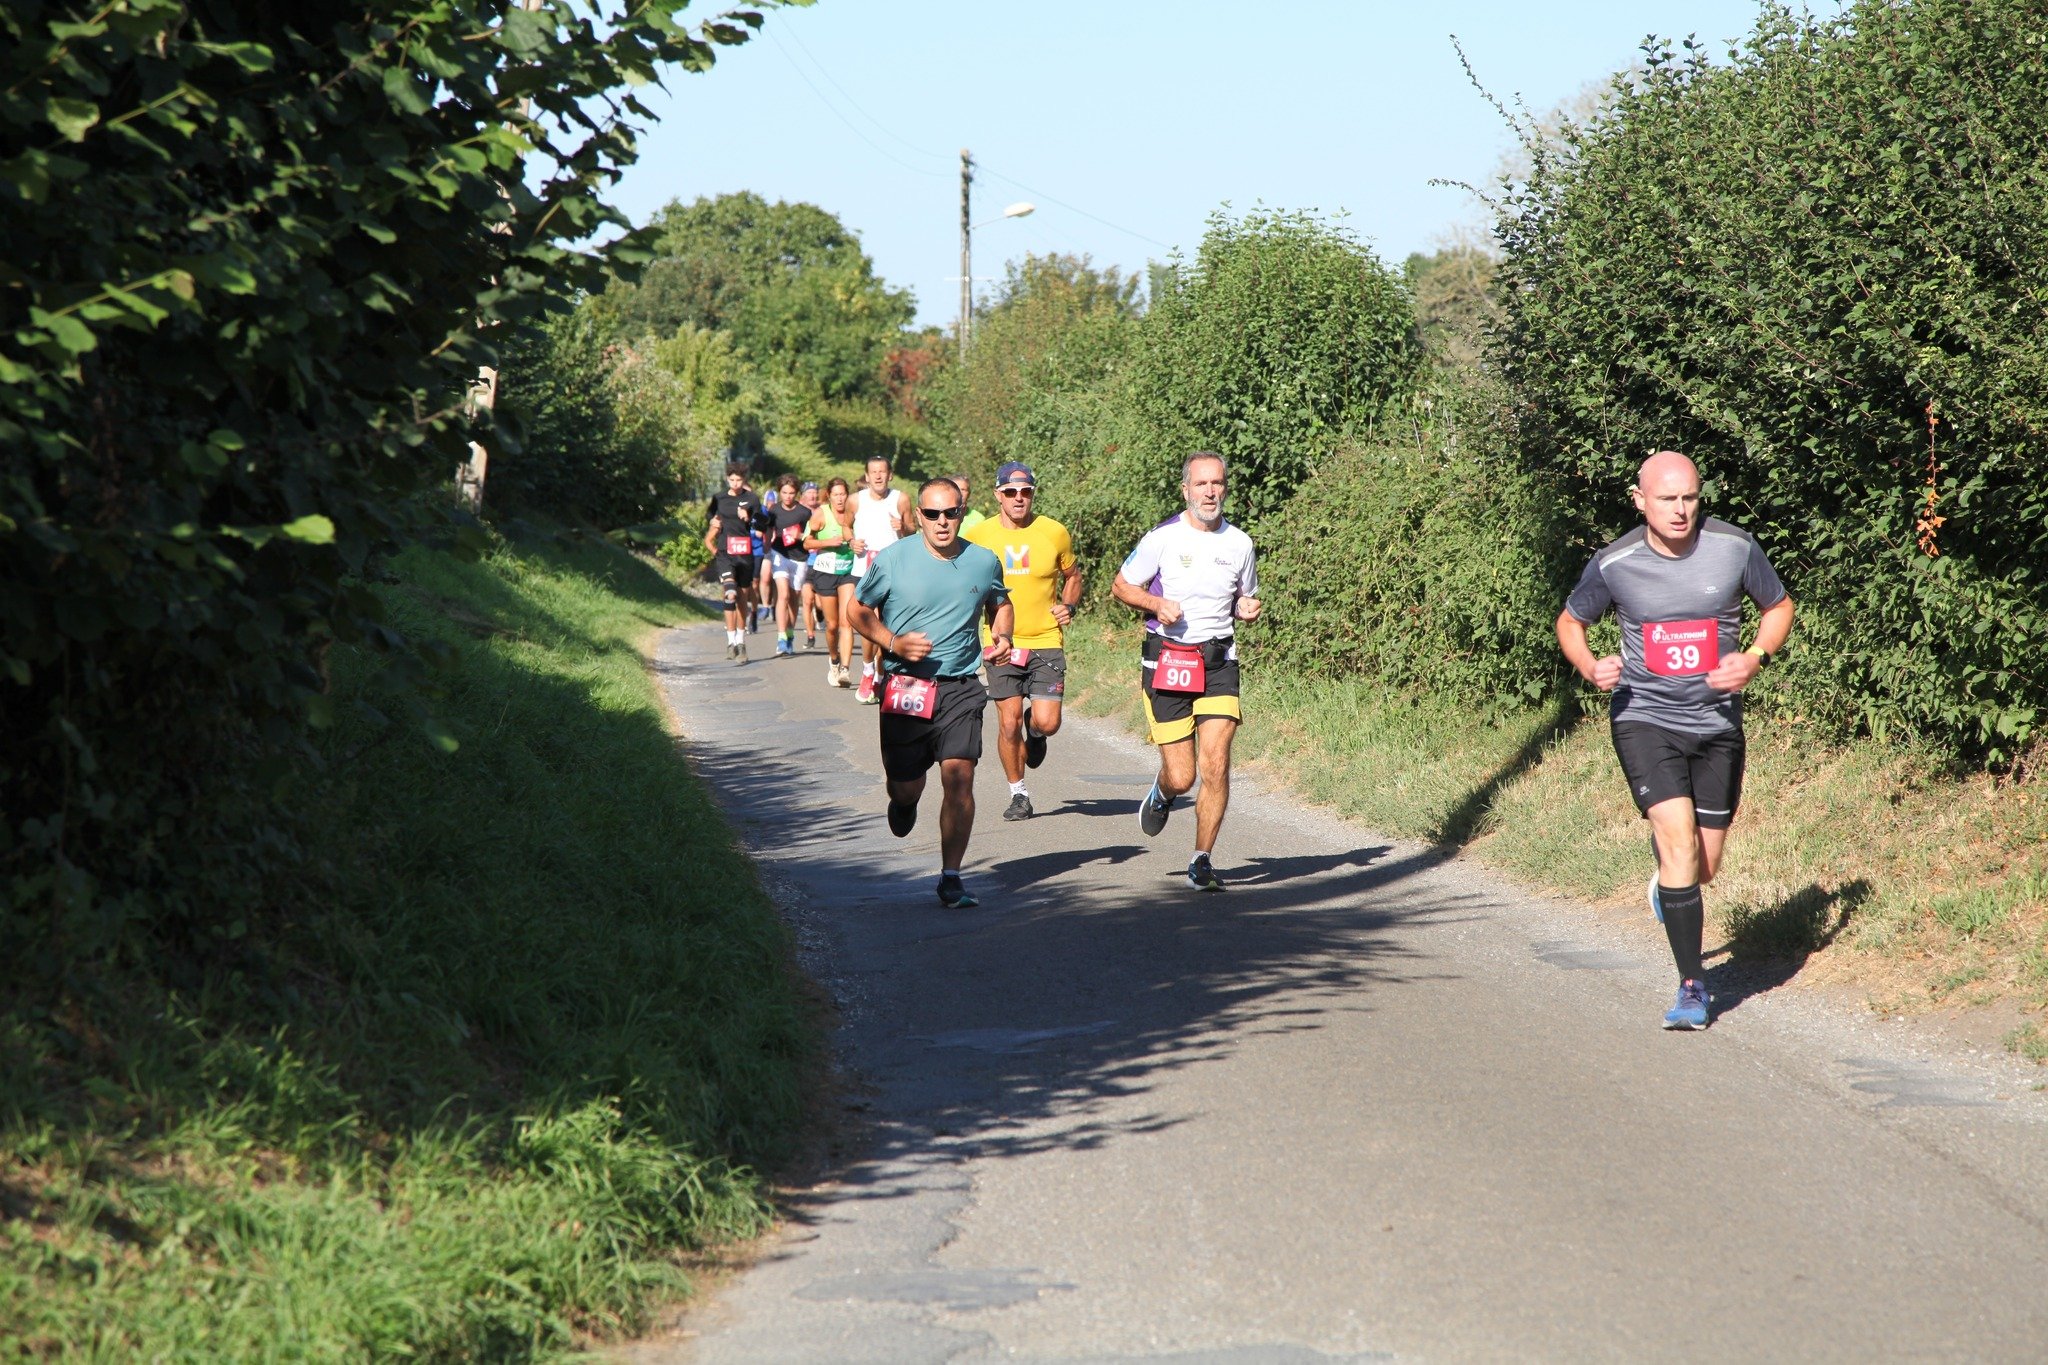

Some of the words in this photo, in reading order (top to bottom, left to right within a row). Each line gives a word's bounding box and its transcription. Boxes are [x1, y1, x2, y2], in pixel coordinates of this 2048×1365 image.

[1662, 630, 1708, 641] ULTRATIMING
[1010, 649, 1021, 662] 3
[1666, 645, 1700, 670] 39
[1166, 668, 1191, 688] 90
[891, 692, 925, 712] 166
